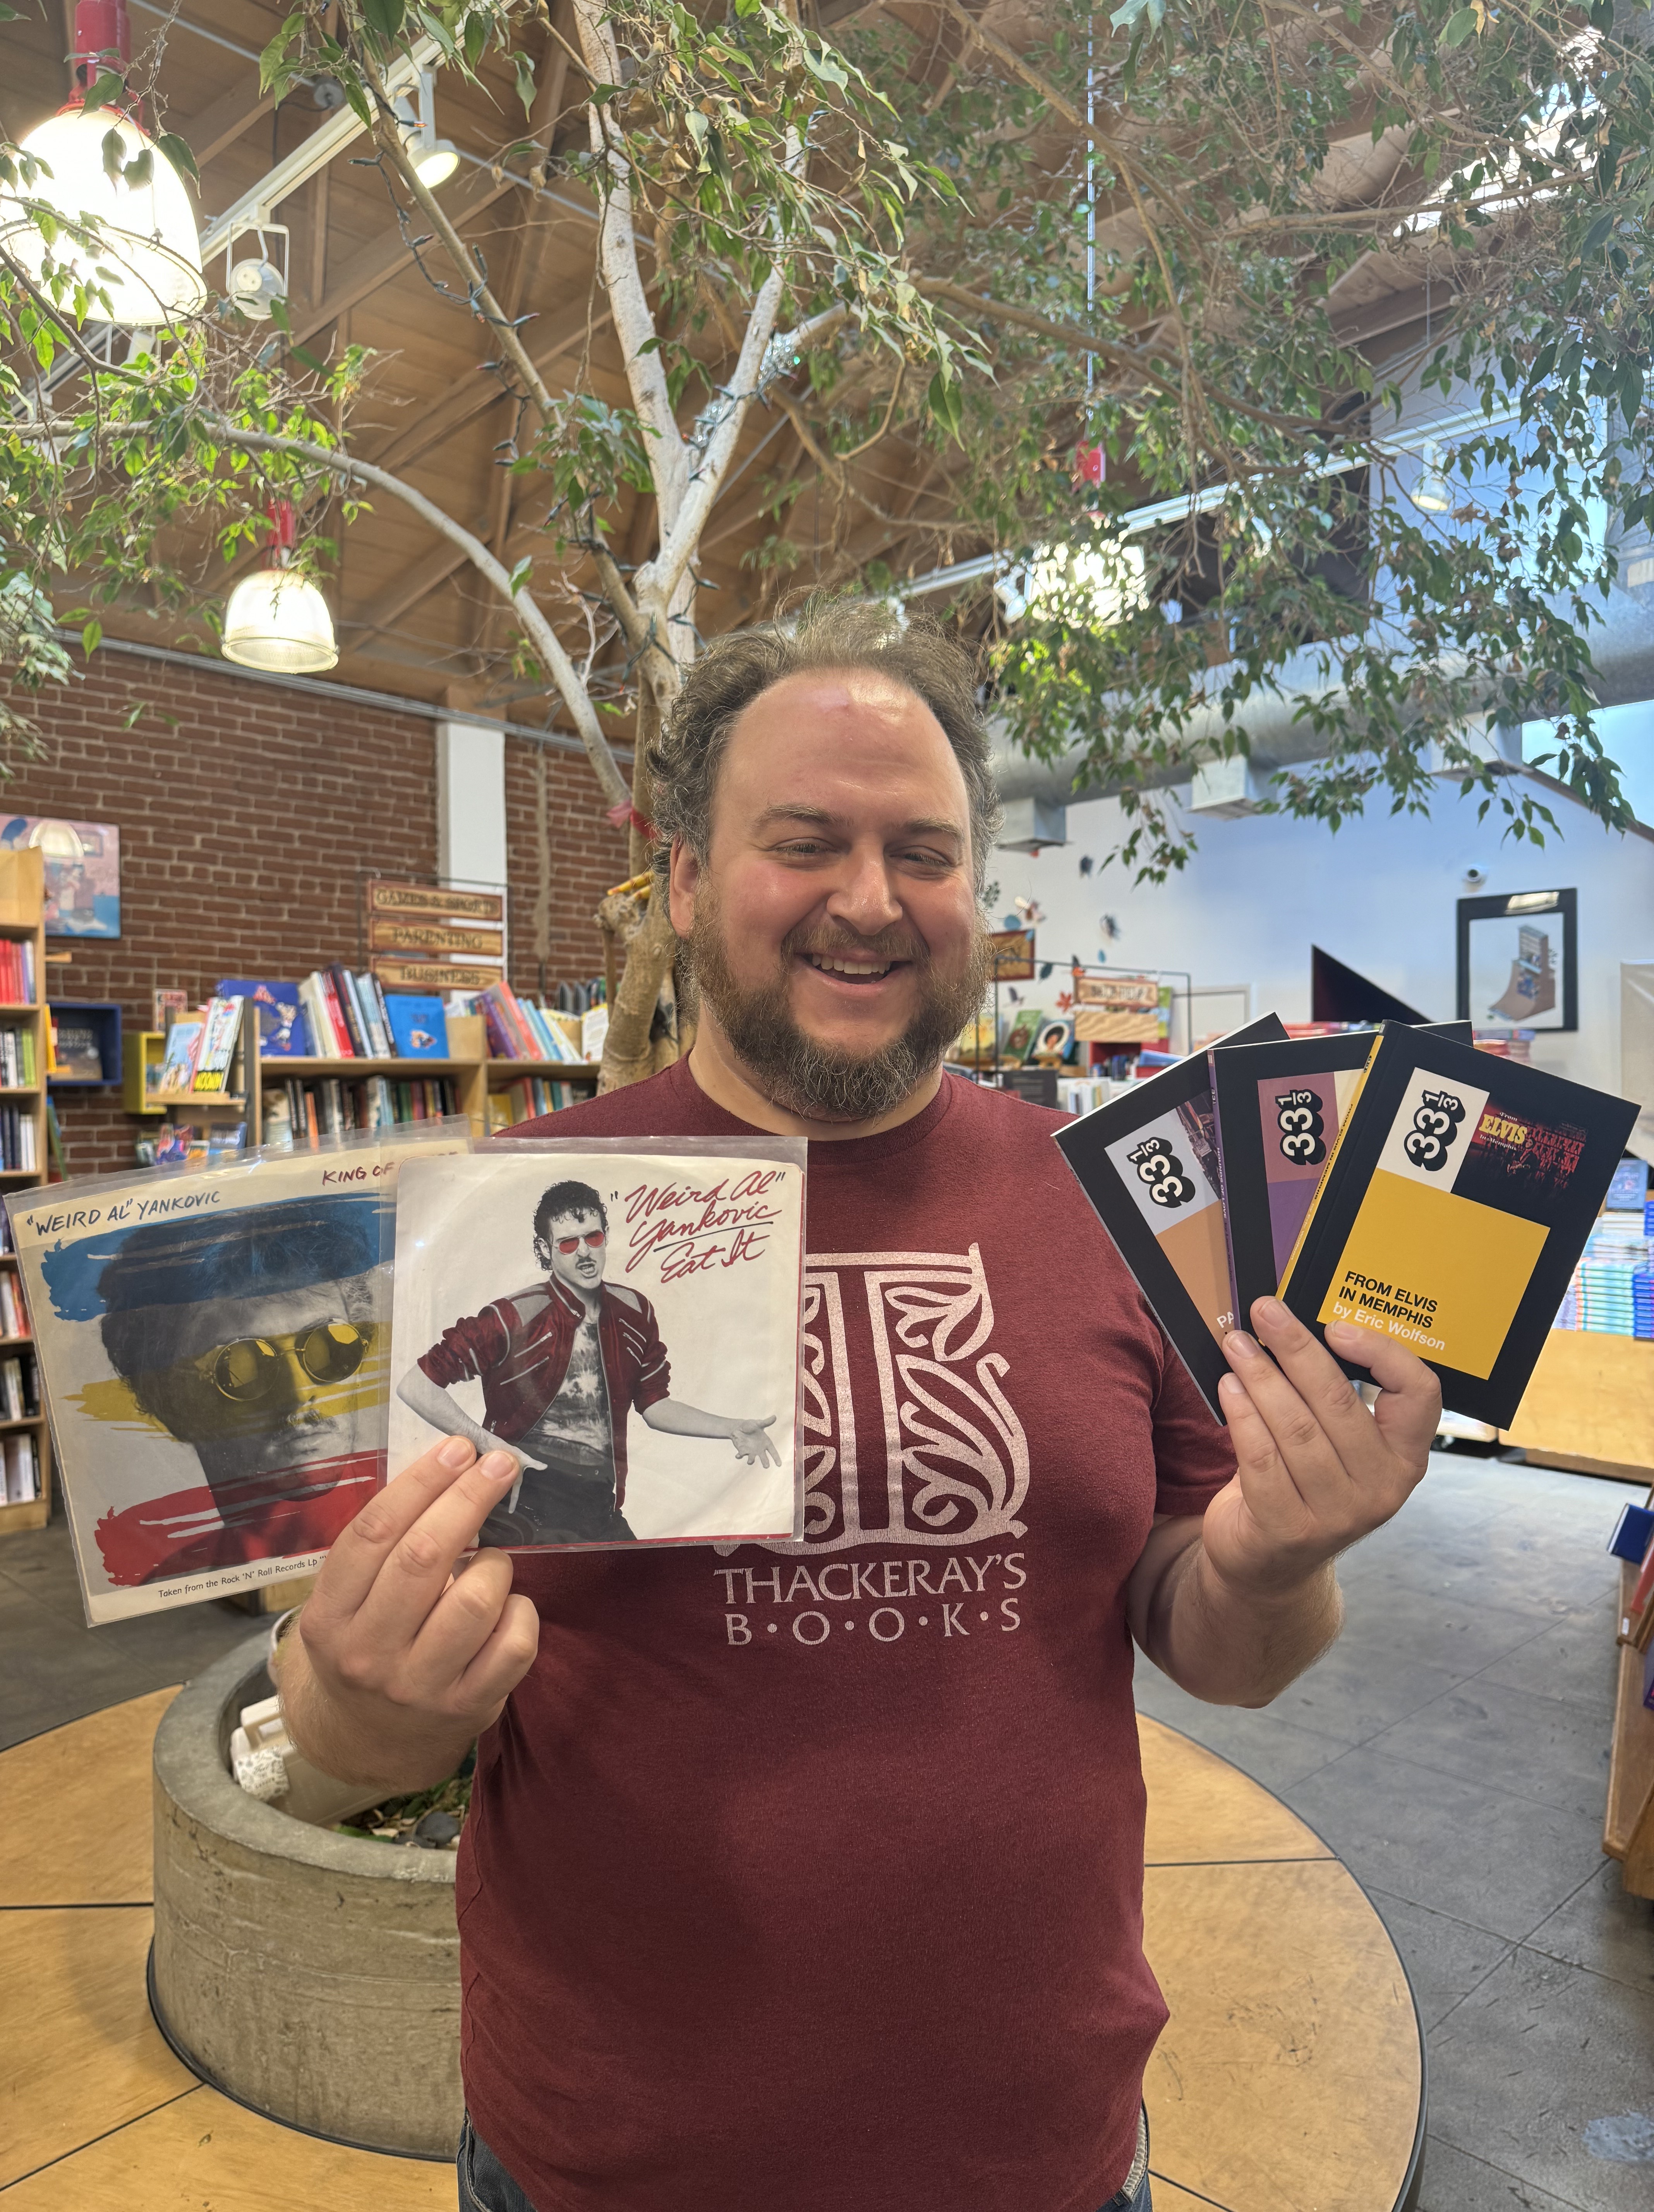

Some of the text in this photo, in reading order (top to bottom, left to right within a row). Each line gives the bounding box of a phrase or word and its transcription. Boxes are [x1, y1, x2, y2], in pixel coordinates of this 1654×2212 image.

[392, 927, 483, 950] PARENTING
[400, 965, 481, 986] BUSINESS
[1479, 1114, 1528, 1144] ELVIS
[322, 1161, 395, 1186] KING OF
[1220, 1185, 1225, 1196] OF
[1314, 1162, 1331, 1200] MEMPHIS
[137, 1191, 220, 1220] YANKOVIC
[625, 1199, 782, 1273] Yankovic
[661, 1229, 770, 1283] Eat It
[1338, 1286, 1433, 1328] IN MEMPHIS
[1345, 1270, 1438, 1312] FROM ELVIS
[1216, 1311, 1234, 1329] PA
[1333, 1301, 1445, 1351] by Eric Wolfson
[158, 1588, 182, 1598] Taken
[185, 1583, 204, 1594] from
[221, 1575, 240, 1585] Rock
[258, 1567, 272, 1577] Roll
[275, 1560, 305, 1573] Records
[308, 1559, 317, 1567] Lp
[713, 1552, 1028, 1605] THACKERAY'S
